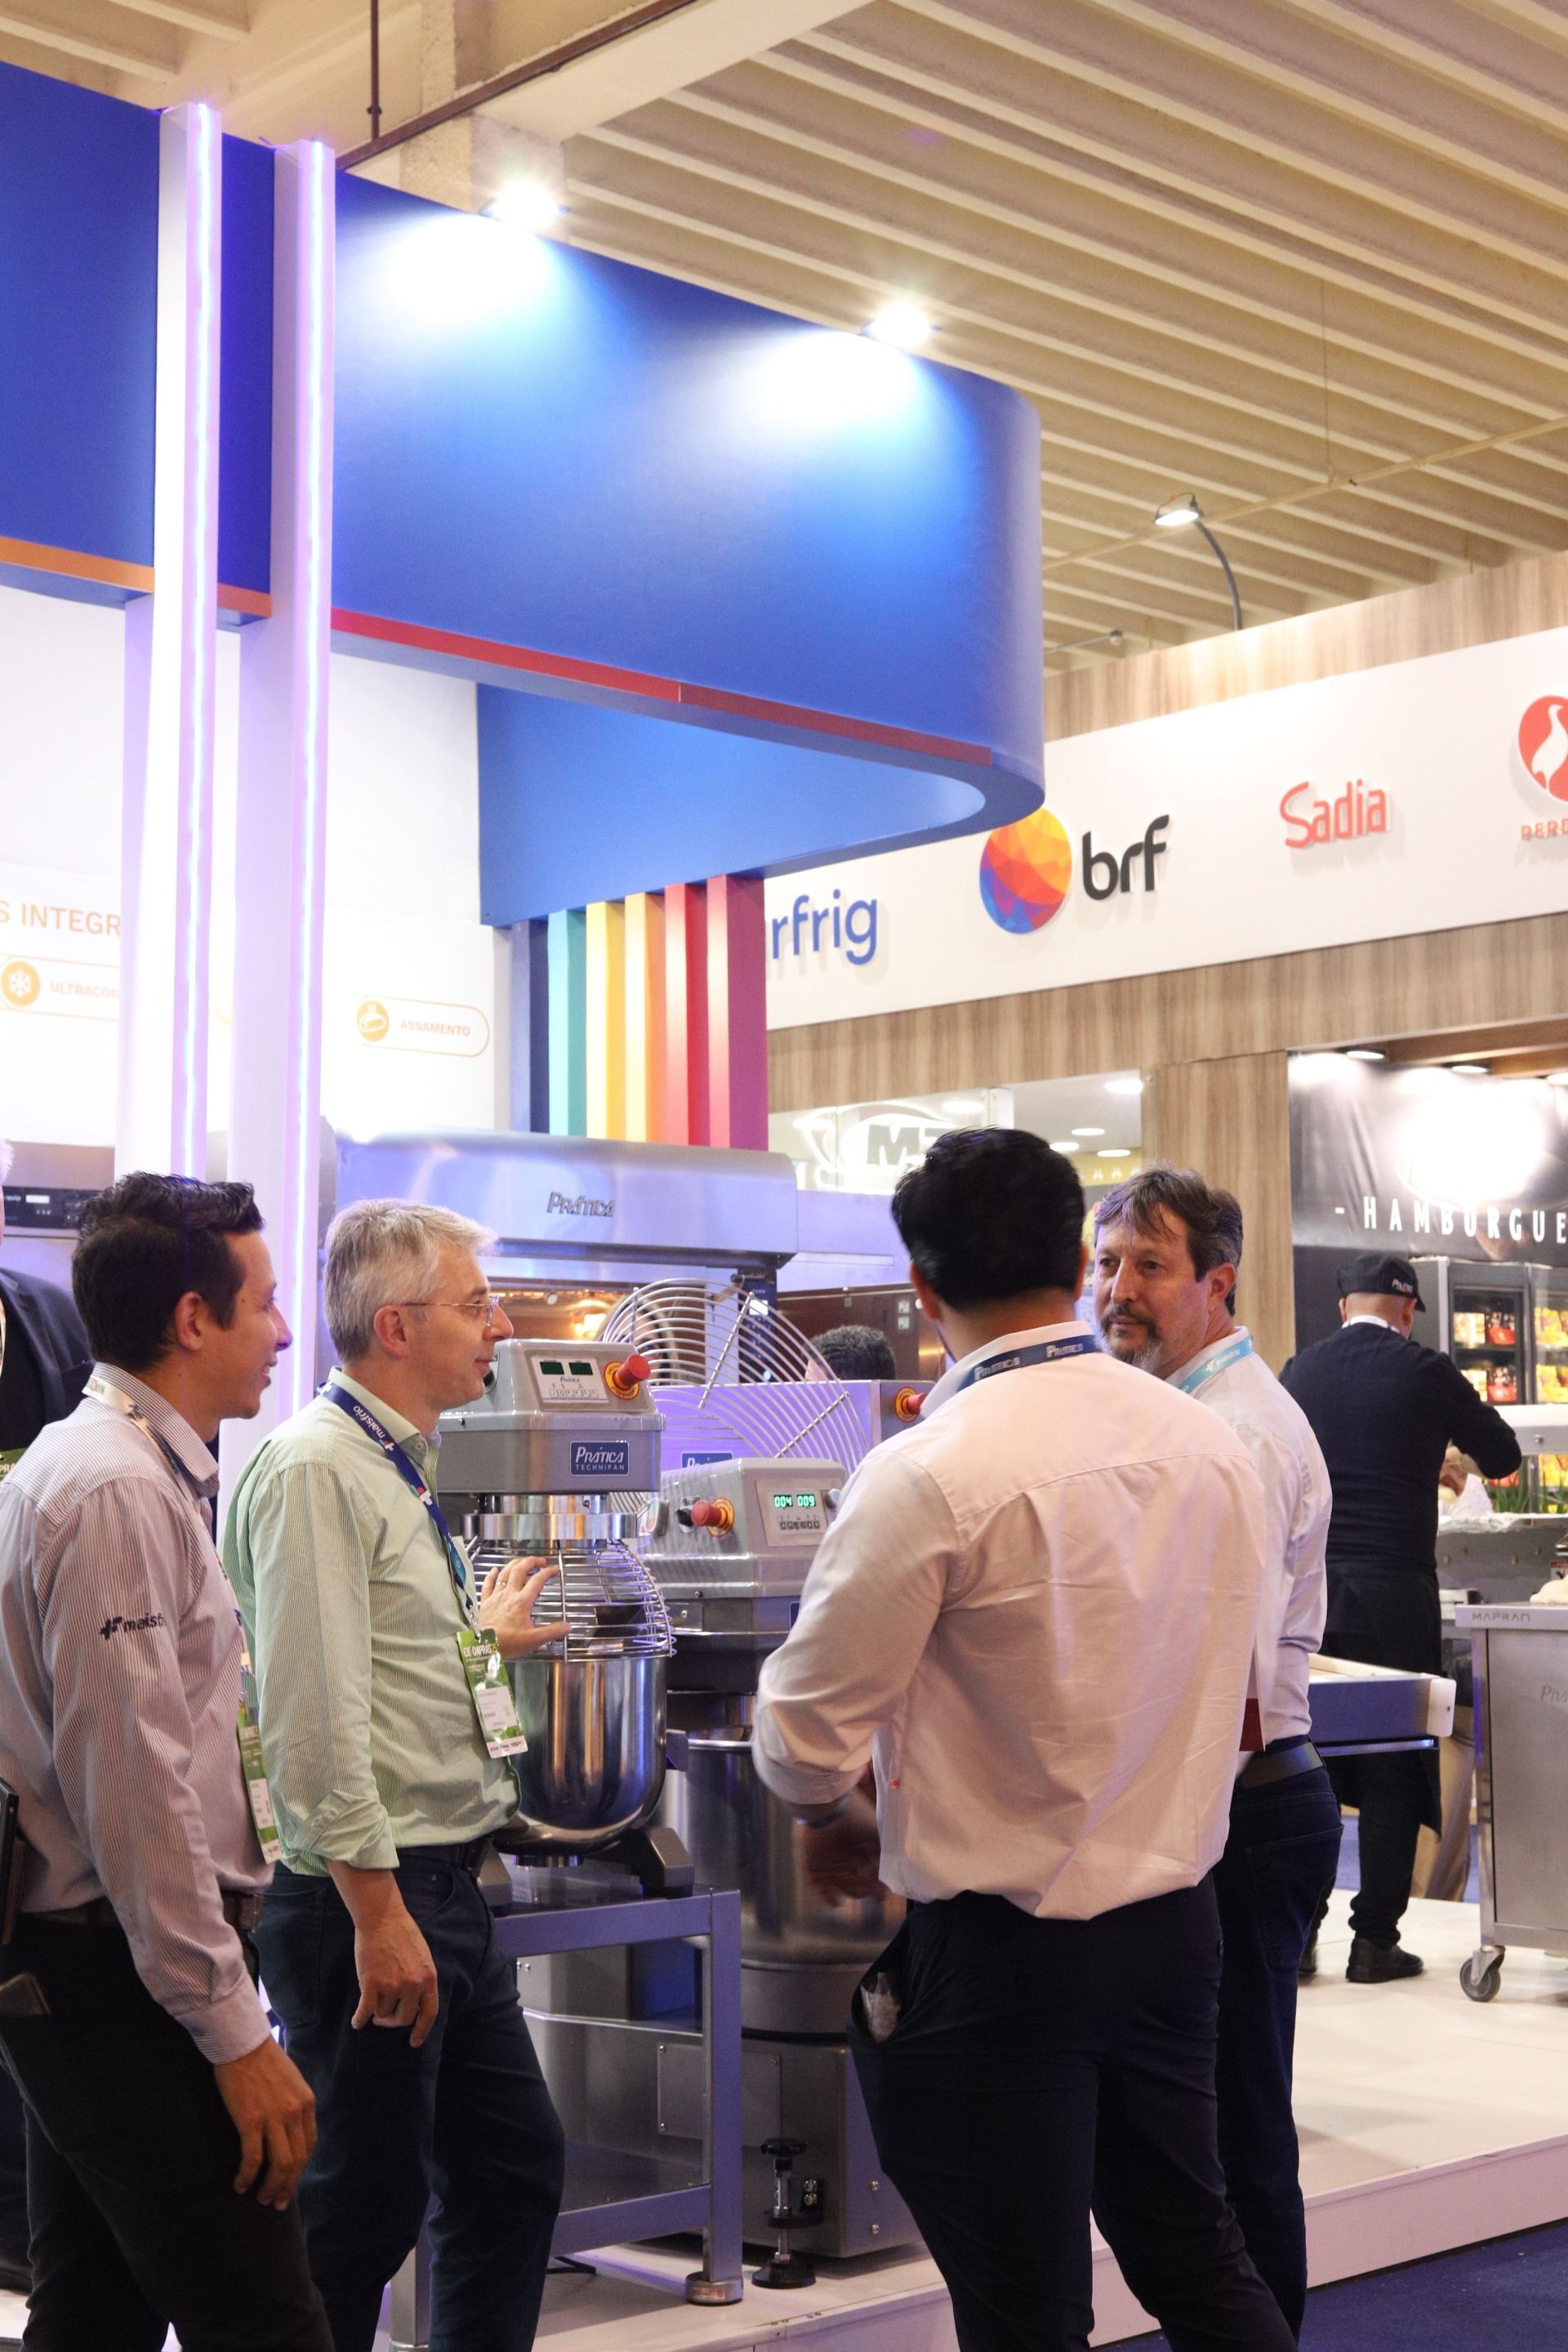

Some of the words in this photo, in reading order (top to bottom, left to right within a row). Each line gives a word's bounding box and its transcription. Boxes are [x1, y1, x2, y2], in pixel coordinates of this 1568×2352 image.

[1280, 778, 1387, 849] Sadia
[1082, 814, 1169, 900] brf
[771, 889, 878, 965] rfrig
[400, 1019, 471, 1036] ASSAMENTO
[353, 1405, 385, 1439] maisfrio
[774, 1495, 792, 1508] 004
[797, 1494, 815, 1507] 009
